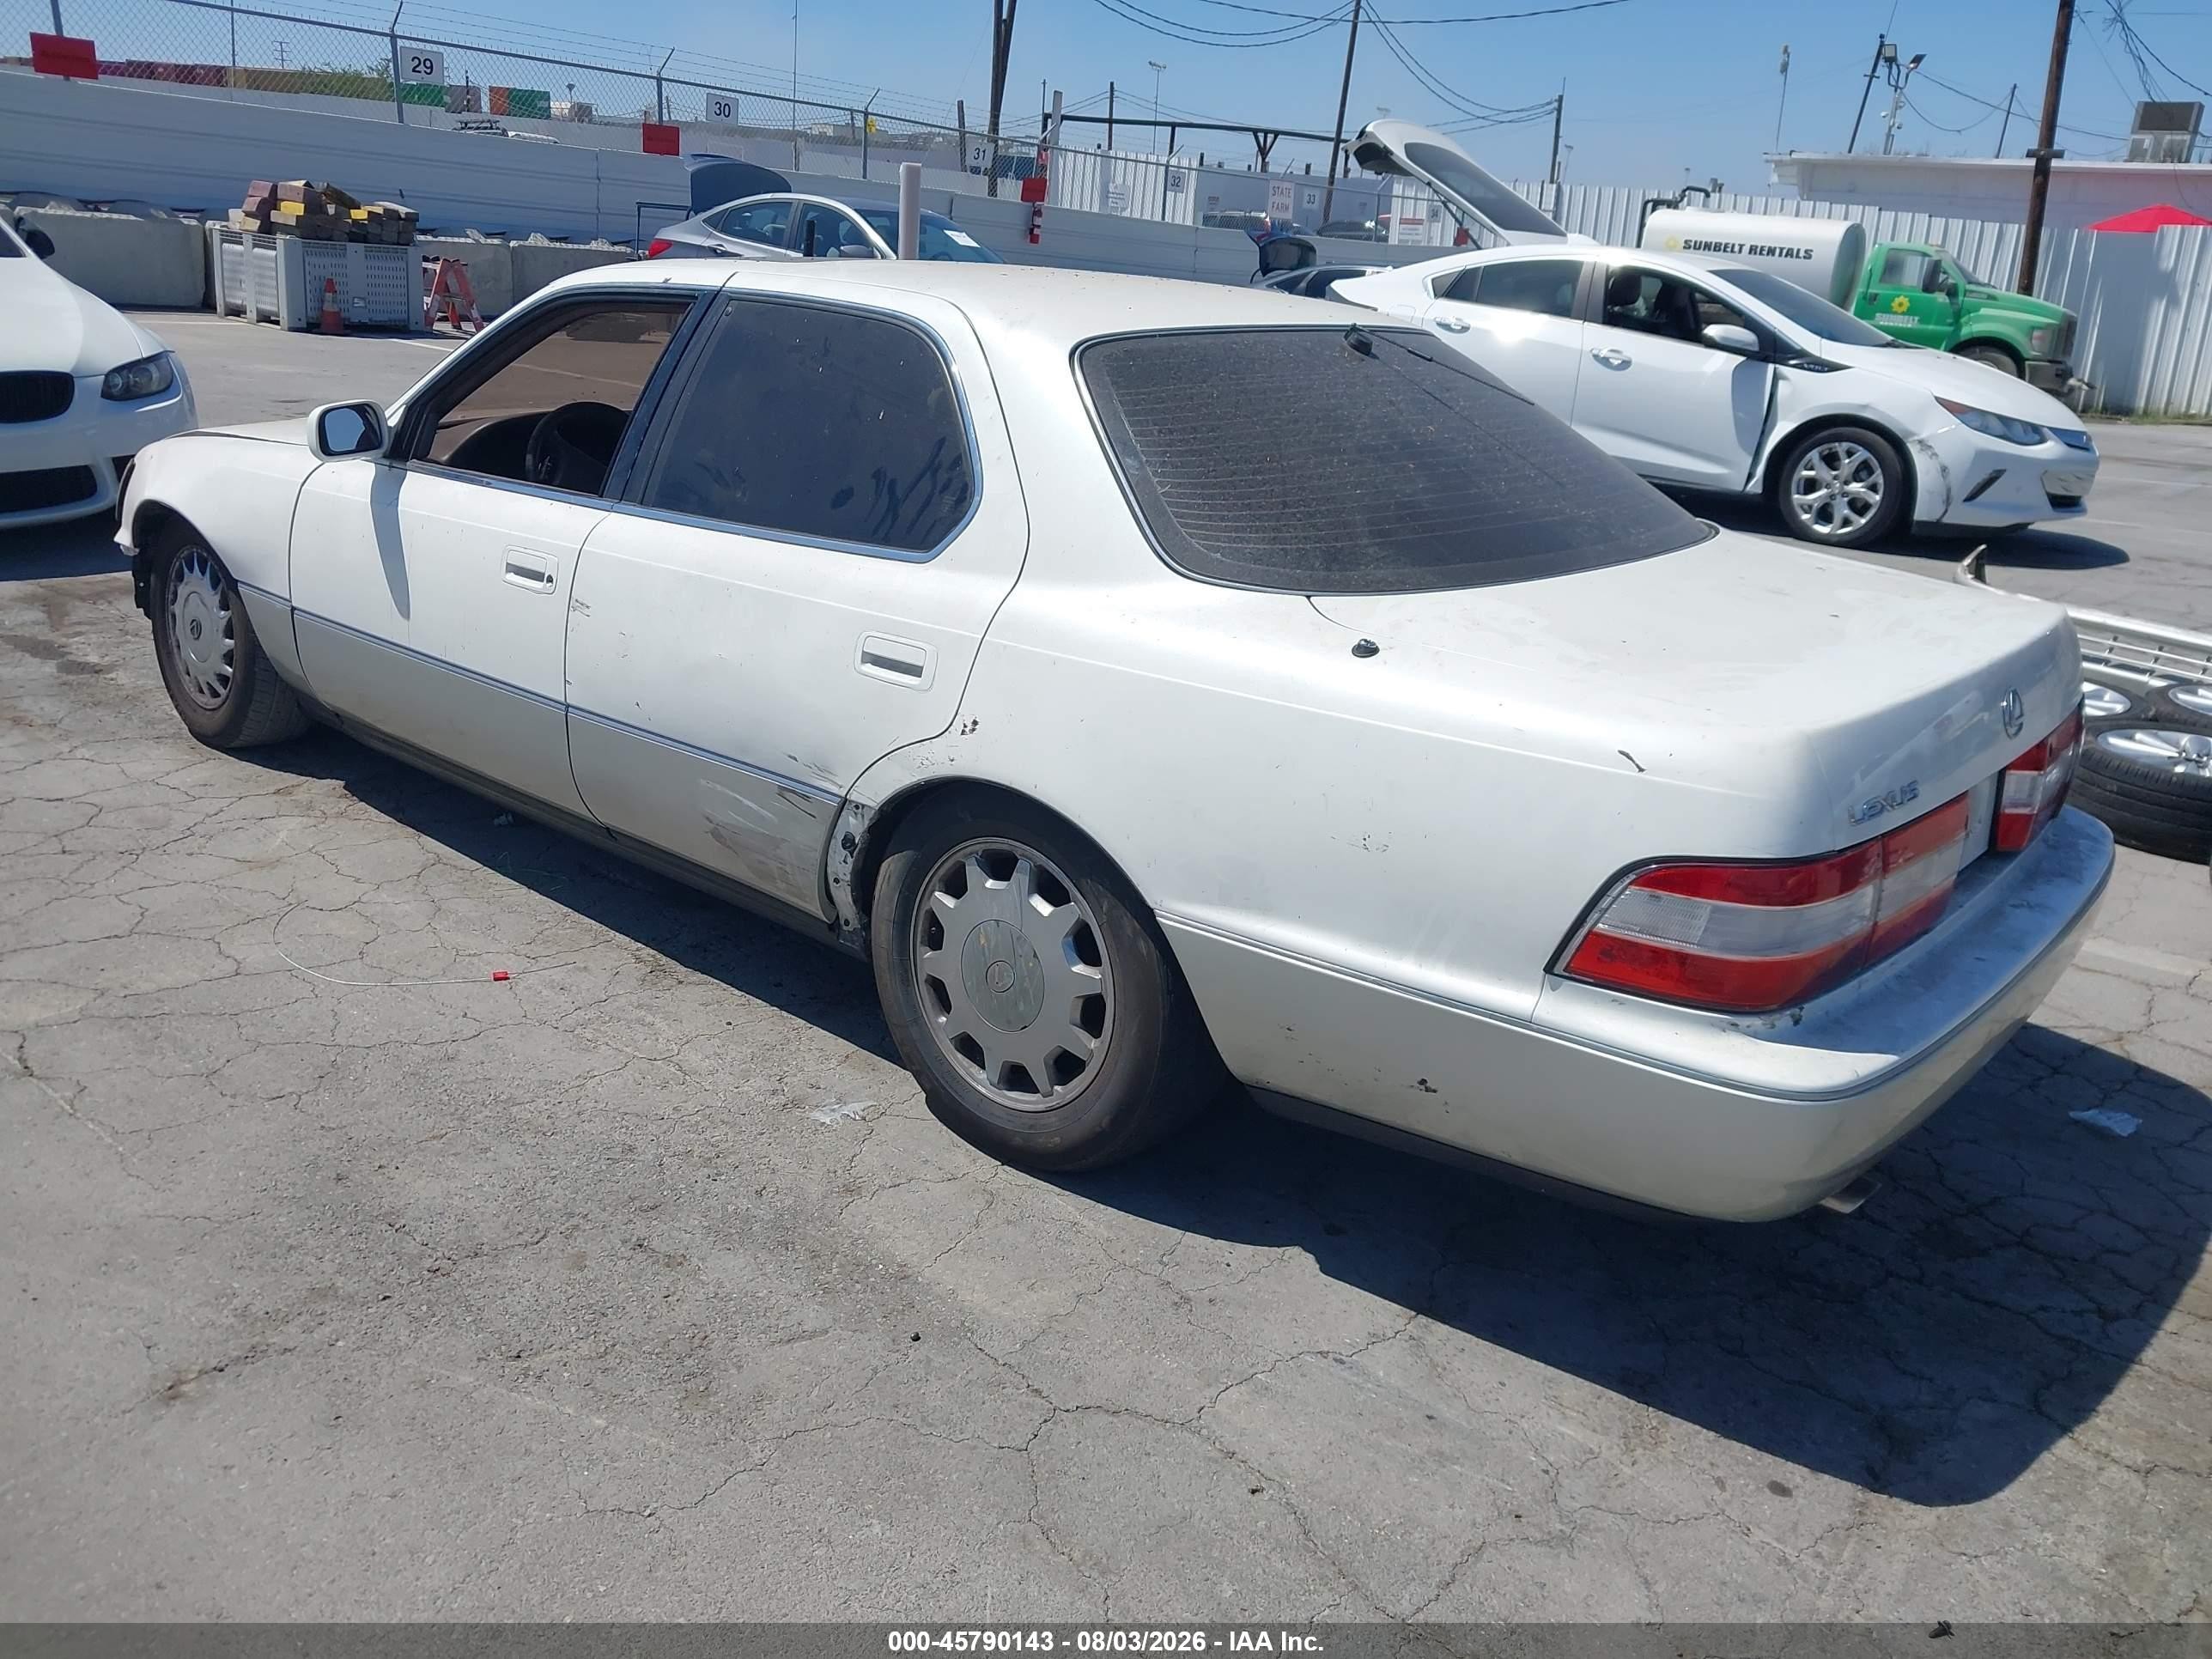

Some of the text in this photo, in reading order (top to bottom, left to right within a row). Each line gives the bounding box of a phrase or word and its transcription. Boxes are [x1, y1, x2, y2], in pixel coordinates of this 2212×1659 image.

[411, 57, 433, 76] 29
[714, 102, 732, 119] 30
[973, 148, 987, 161] 31
[1170, 175, 1181, 188] 32
[1272, 186, 1292, 199] STATE
[1306, 194, 1316, 205] 33
[1271, 201, 1291, 213] FARM
[1682, 240, 1814, 259] SUNBELT RENTALS
[1849, 779, 1919, 827] LEXUS
